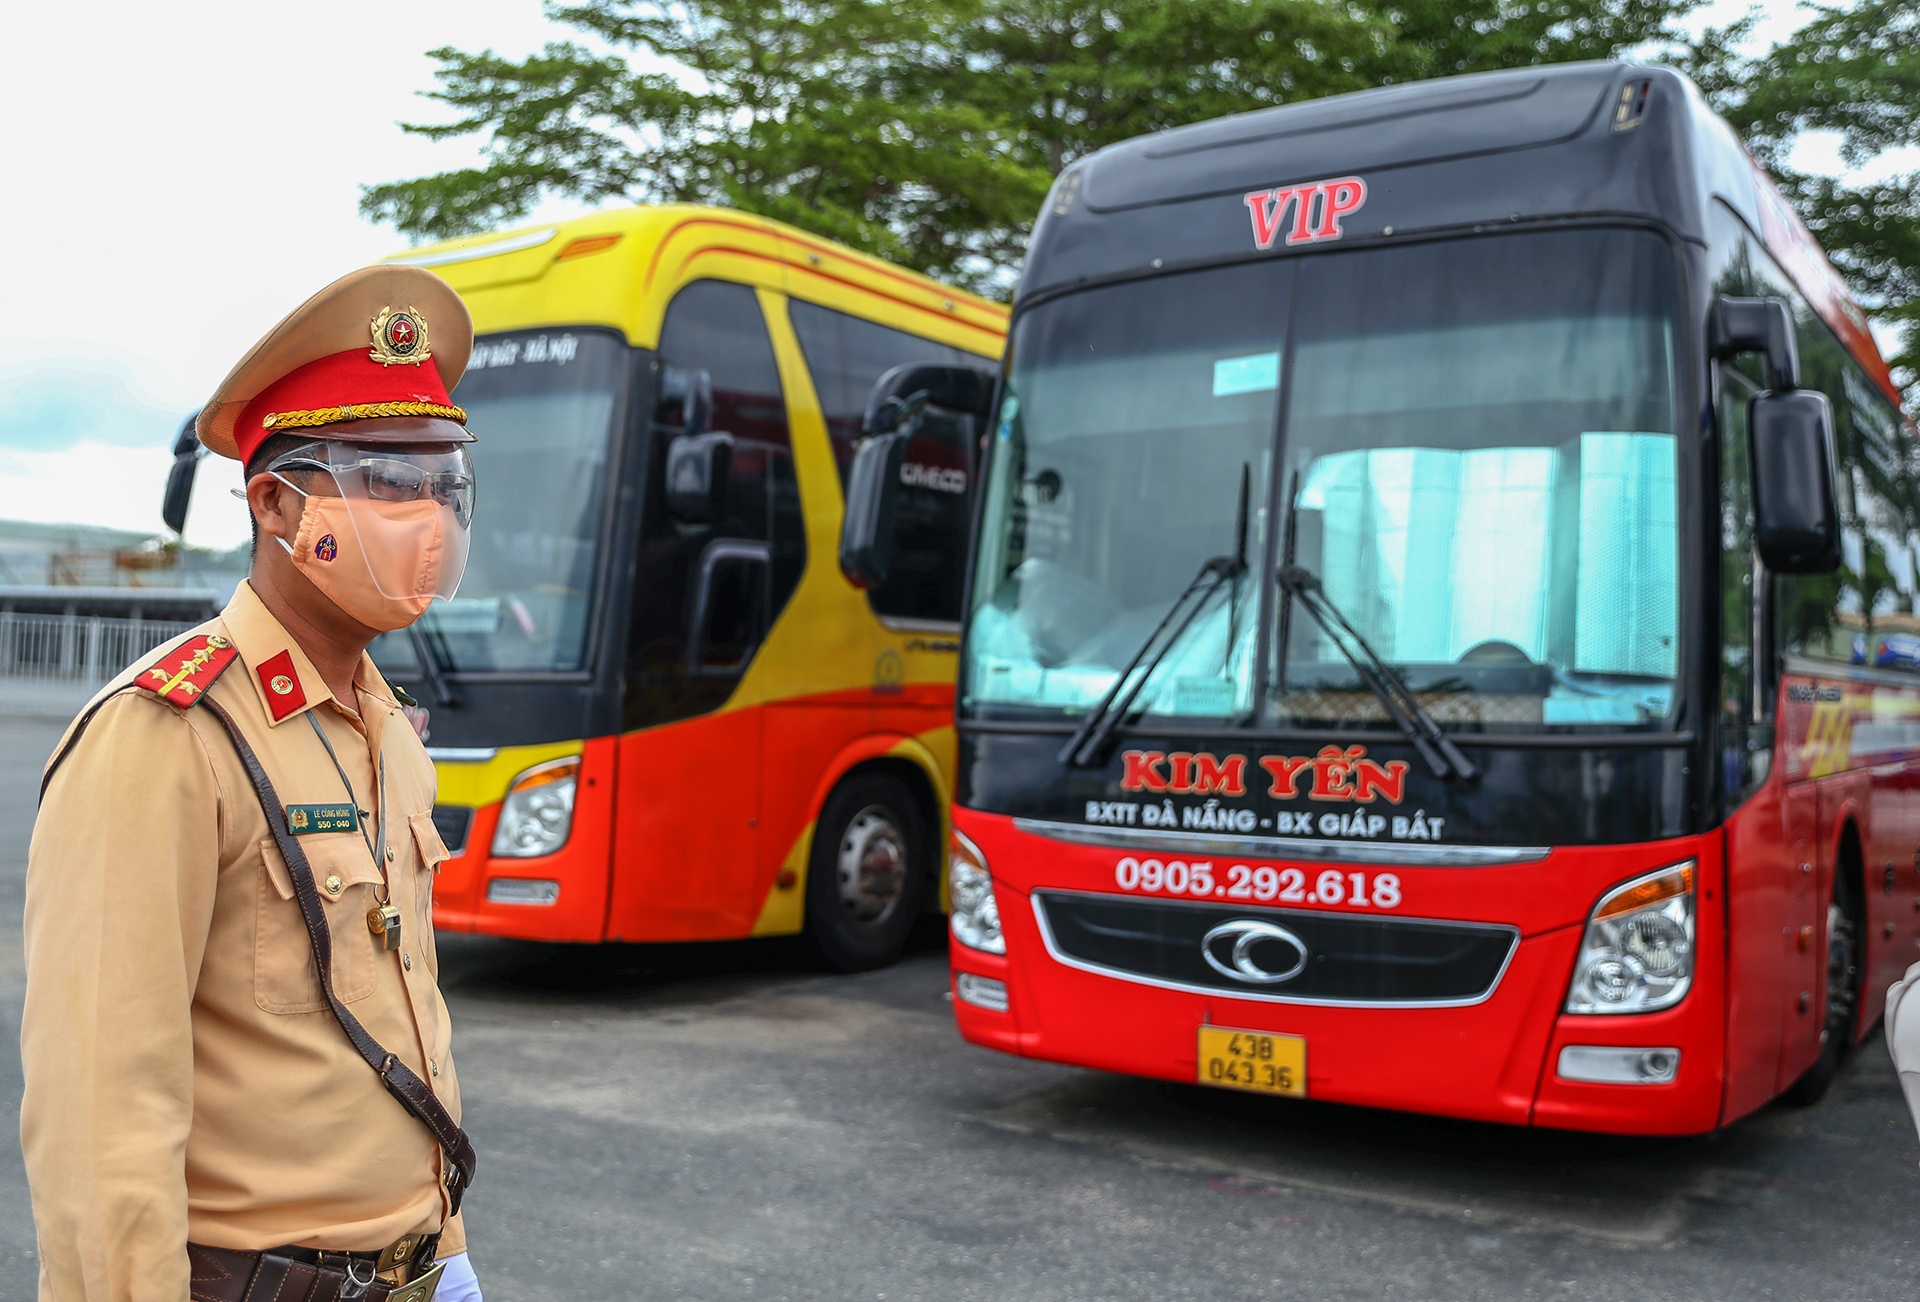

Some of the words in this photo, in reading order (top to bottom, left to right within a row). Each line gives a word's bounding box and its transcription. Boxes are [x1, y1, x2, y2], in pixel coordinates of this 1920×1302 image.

[1244, 175, 1368, 250] VIP
[1121, 750, 1248, 797] KIM
[1259, 744, 1410, 804] YẾN
[317, 820, 331, 829] 550
[336, 820, 350, 828] 040
[1085, 801, 1139, 825] BXTT
[1142, 798, 1179, 828] ĐÀ
[1277, 811, 1314, 835] BX
[1318, 807, 1387, 838] GIÁP
[1391, 809, 1445, 841] BÁT
[1115, 856, 1402, 908] 0905.292.618
[1228, 1033, 1273, 1060] 43B
